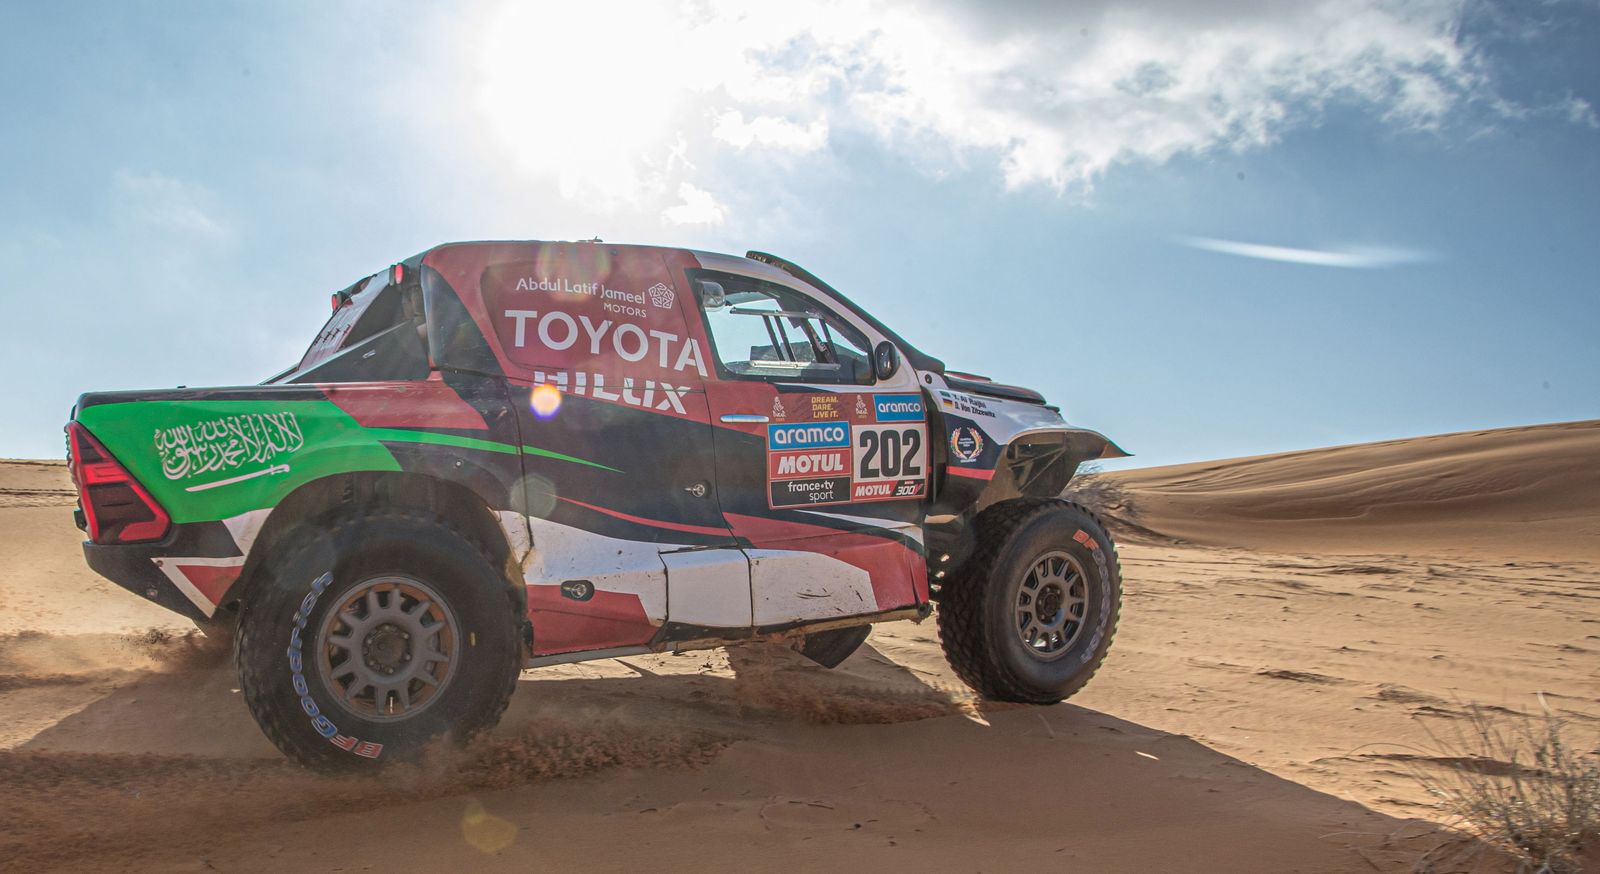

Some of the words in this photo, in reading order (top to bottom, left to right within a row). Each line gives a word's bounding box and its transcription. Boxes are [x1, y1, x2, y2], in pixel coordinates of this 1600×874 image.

[516, 278, 561, 291] Abdul
[565, 279, 598, 296] Latif
[600, 285, 646, 305] Jameel
[603, 303, 647, 318] MOTORS
[504, 309, 708, 377] TOYOTA
[534, 371, 691, 415] HILUX
[811, 396, 839, 404] DREAM.
[812, 403, 834, 411] DARE.
[813, 410, 829, 419] LIVE
[878, 402, 921, 413] aramco
[774, 427, 845, 444] aramco
[859, 429, 921, 479] 202
[777, 453, 844, 475] MOTUL
[809, 491, 834, 504] sport
[854, 484, 891, 497] MOTUL
[286, 571, 384, 759] BFGoodrich
